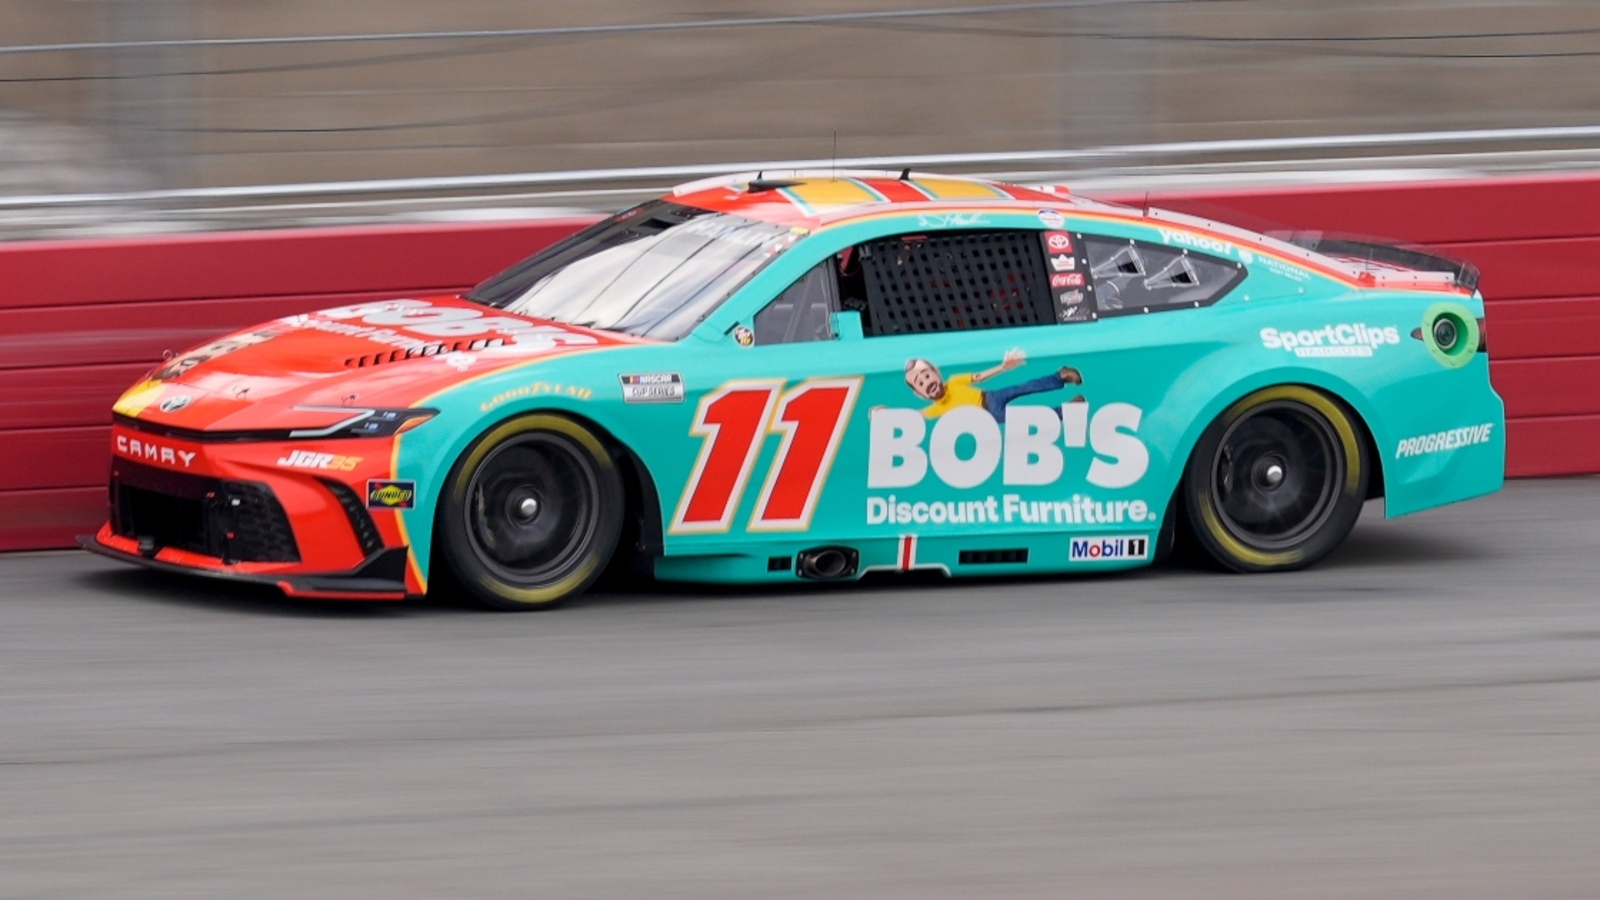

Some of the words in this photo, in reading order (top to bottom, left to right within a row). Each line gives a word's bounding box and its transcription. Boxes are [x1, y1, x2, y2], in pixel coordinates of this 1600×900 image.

[1158, 229, 1233, 255] yahoo!
[1258, 255, 1312, 281] NATIONAL
[1260, 323, 1400, 352] SportClips
[632, 386, 648, 397] CUP
[649, 385, 675, 396] SERIES
[639, 374, 672, 384] NASCAR
[116, 435, 196, 467] CAMRY
[867, 402, 1150, 489] BOB'S
[1395, 423, 1493, 459] PROGRESSIVE
[669, 377, 865, 535] 11
[370, 489, 412, 501] SUNOCO
[867, 495, 999, 525] Discount
[1072, 539, 1123, 558] Mobil
